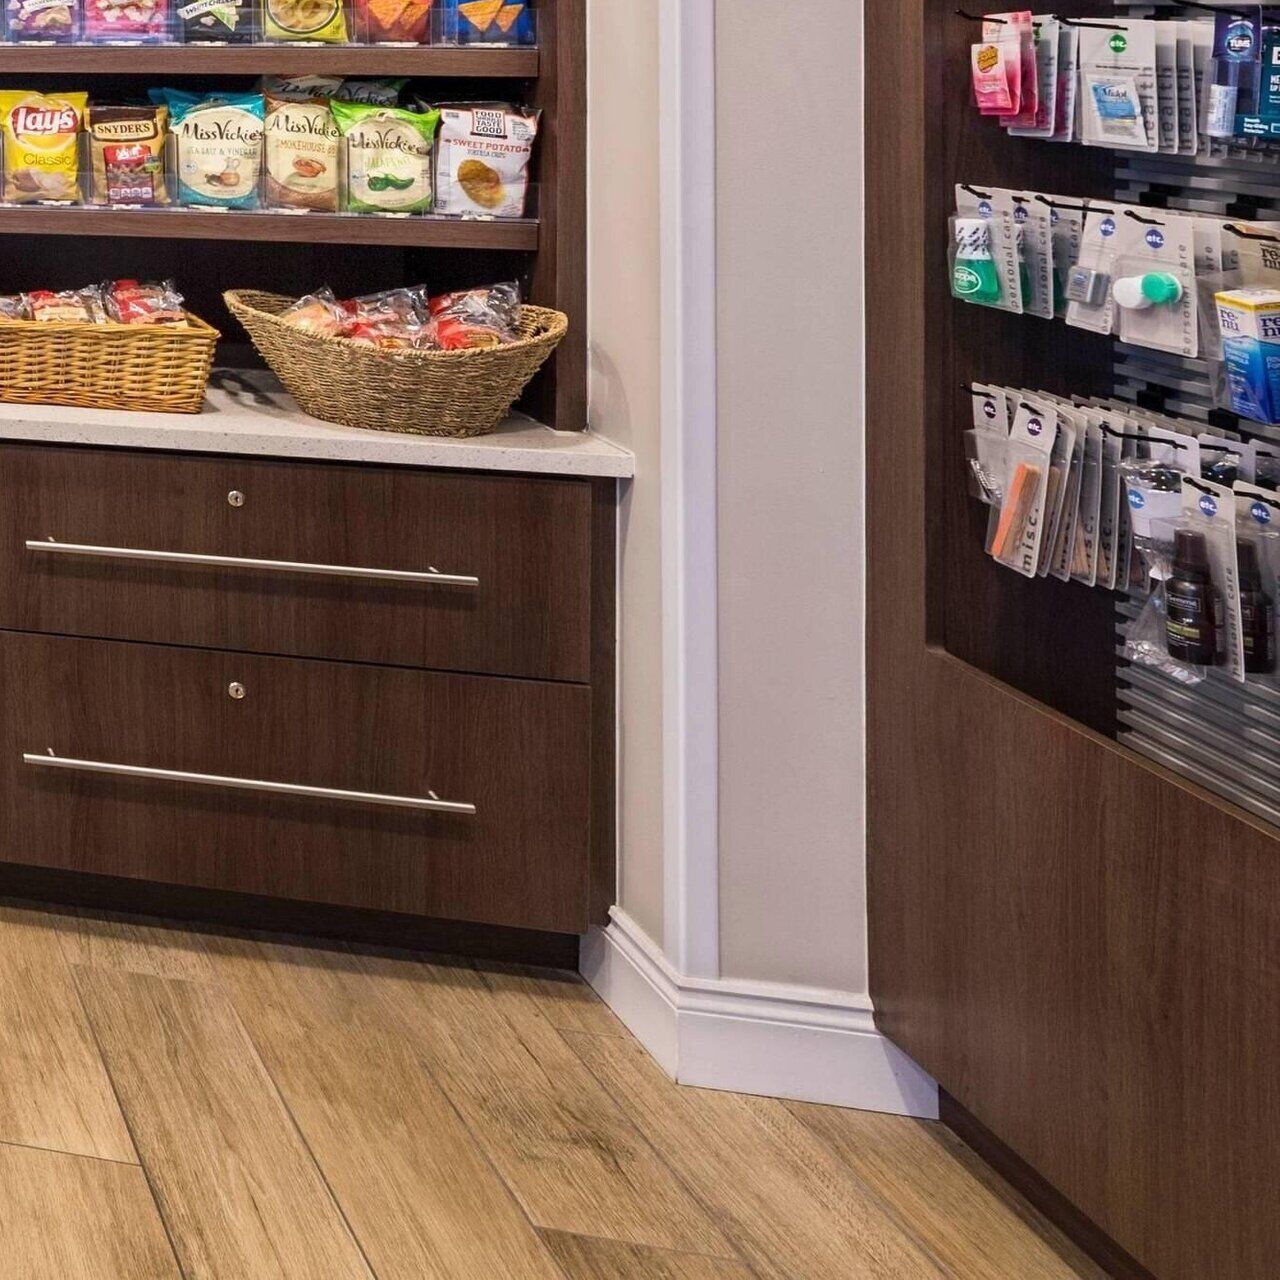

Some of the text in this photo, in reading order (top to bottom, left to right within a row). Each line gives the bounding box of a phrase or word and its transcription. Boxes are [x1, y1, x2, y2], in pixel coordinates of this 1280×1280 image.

[1108, 38, 1127, 48] etc.
[1229, 39, 1251, 48] TUMS
[17, 106, 75, 136] Lay's
[475, 110, 502, 119] FOOD
[97, 121, 151, 134] SNYDER'S
[269, 114, 306, 134] Miss
[475, 126, 503, 134] GOOD
[183, 119, 264, 143] Miss Vickie's
[348, 131, 379, 149] Miss
[452, 138, 522, 153] SWEET POTATO
[227, 148, 258, 157] VINEGAR
[23, 152, 72, 167] Classic
[1100, 223, 1115, 232] etc.
[1145, 234, 1165, 244] etc.
[1004, 245, 1020, 308] personal
[1183, 282, 1192, 355] personal
[1221, 318, 1240, 332] nu
[1027, 422, 1042, 432] etc.
[1199, 500, 1218, 512] etc.
[1252, 506, 1272, 519] etc.
[1021, 507, 1039, 573] misc.
